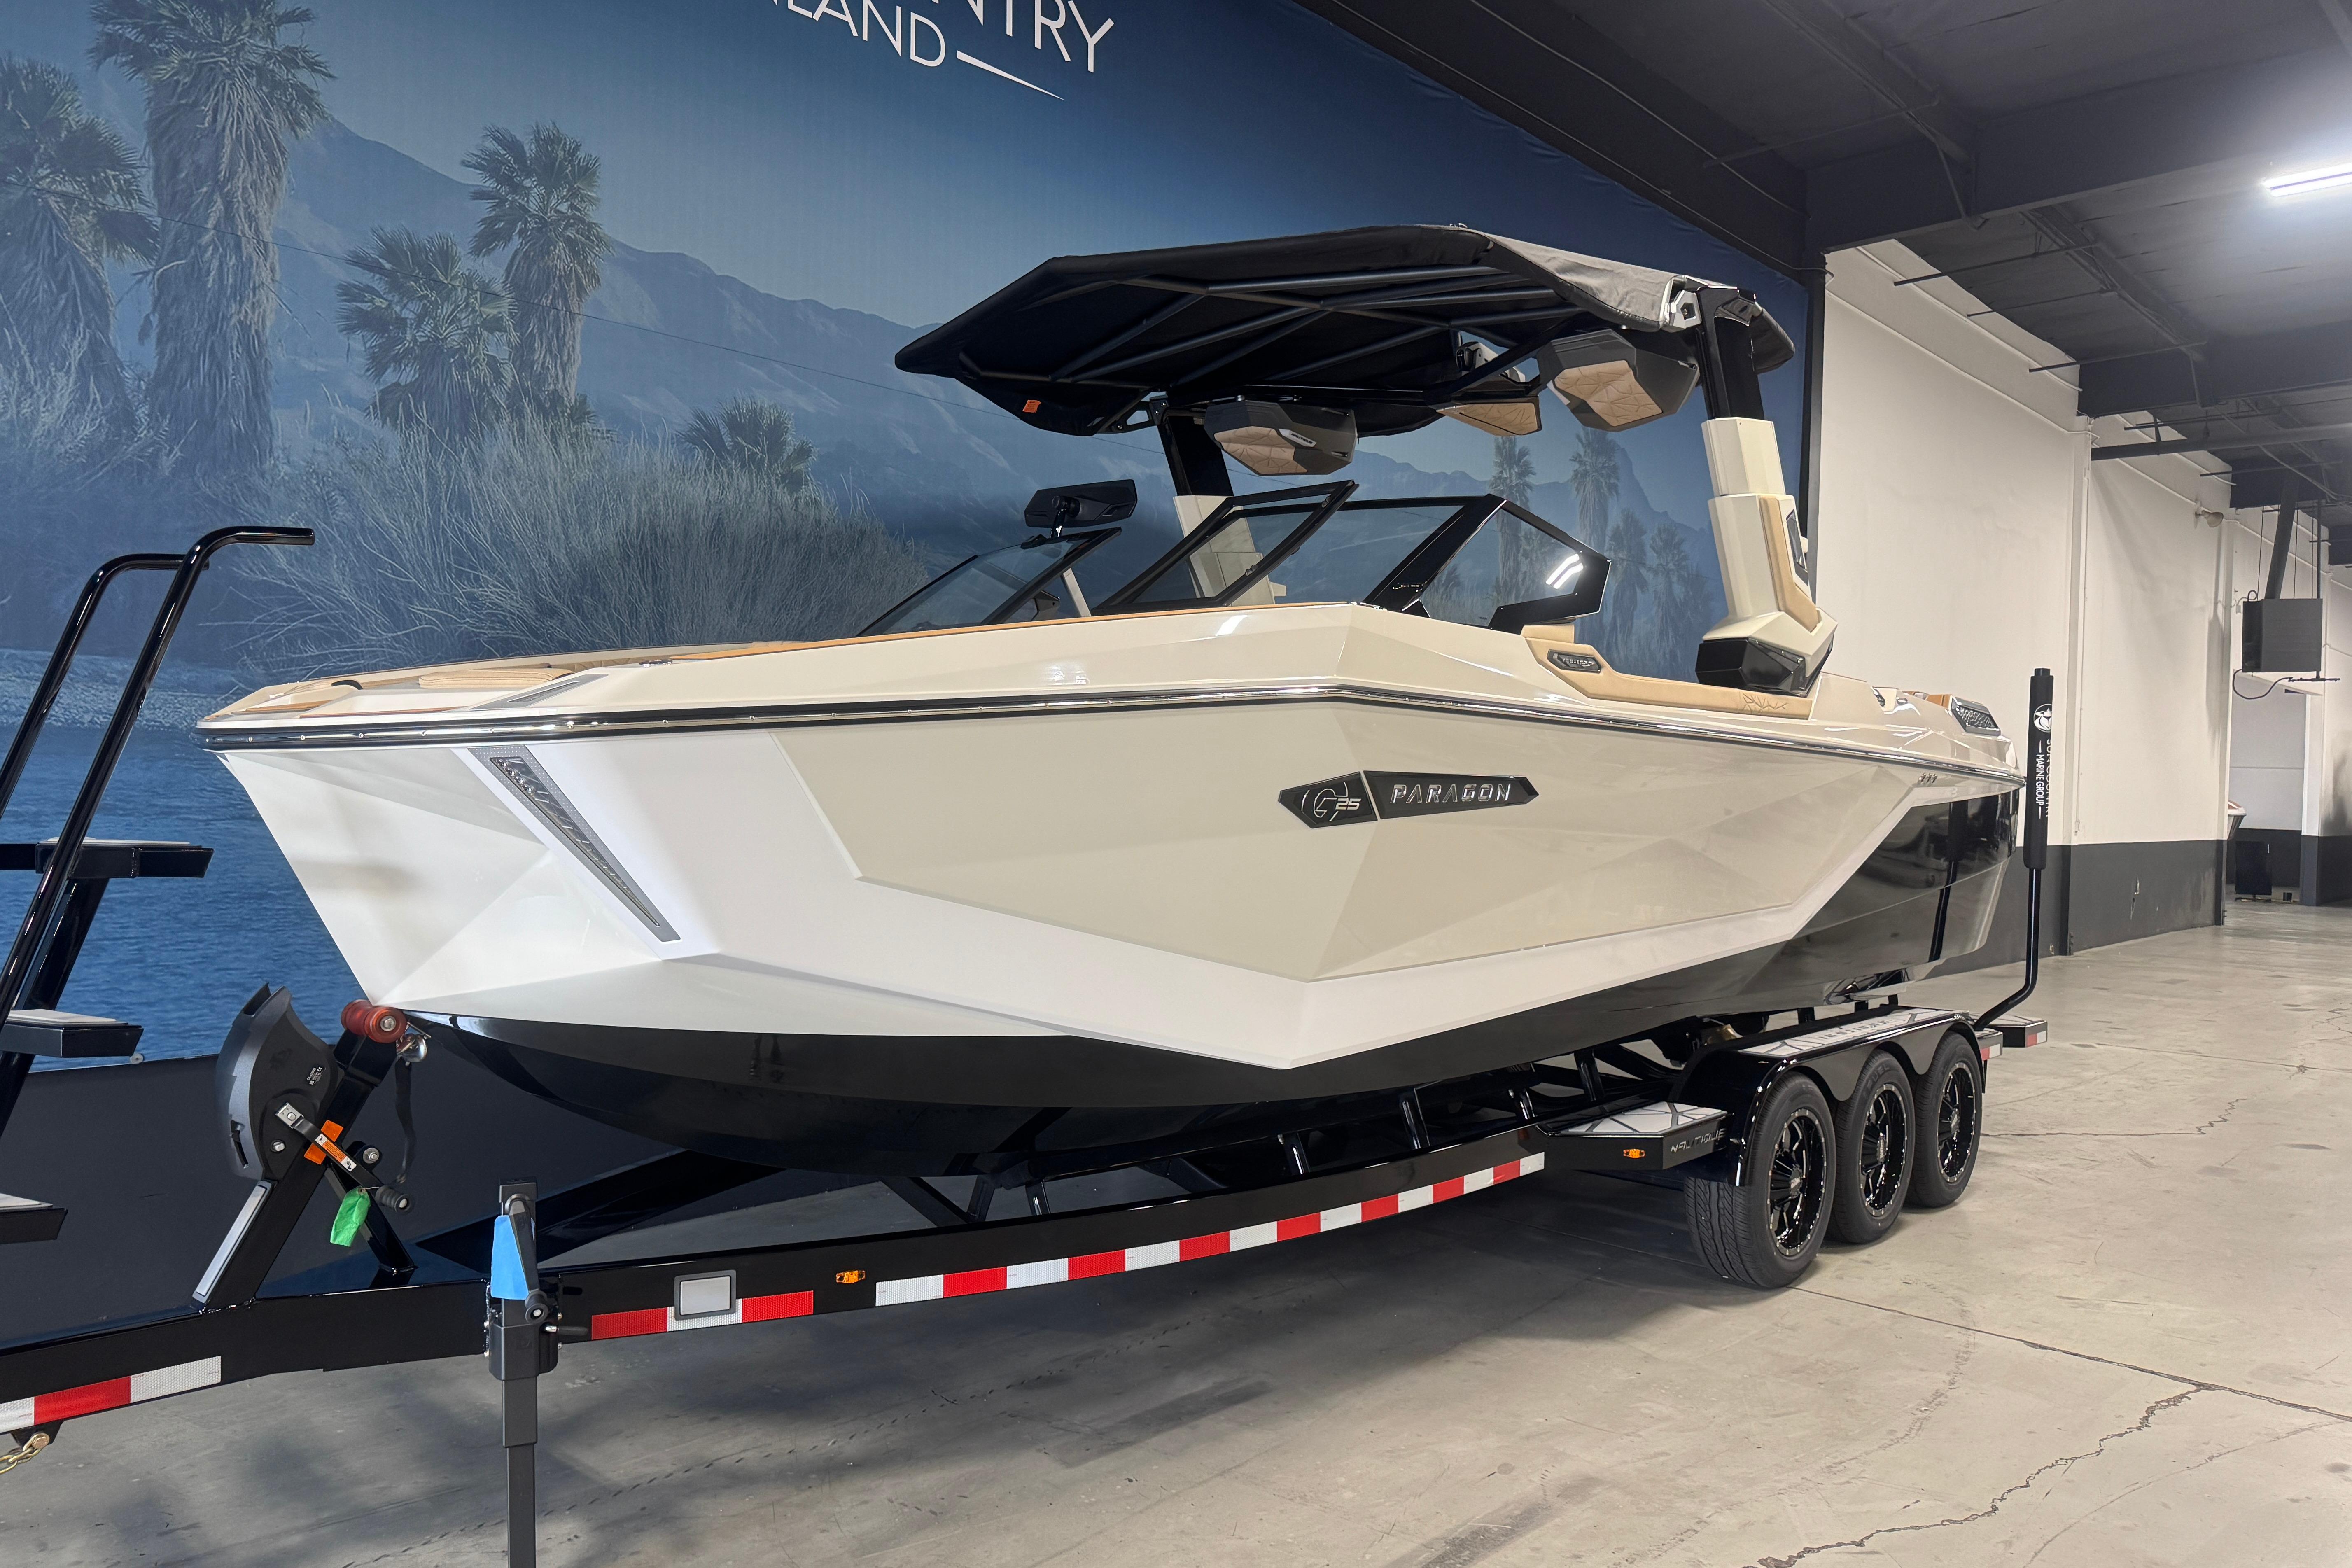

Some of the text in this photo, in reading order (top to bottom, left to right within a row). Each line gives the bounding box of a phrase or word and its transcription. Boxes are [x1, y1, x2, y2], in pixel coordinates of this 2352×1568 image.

[2036, 754, 2045, 806] MARINE GROUP
[1389, 784, 1511, 804] PARAGON
[1671, 1128, 1727, 1153] NAUTIQUE
